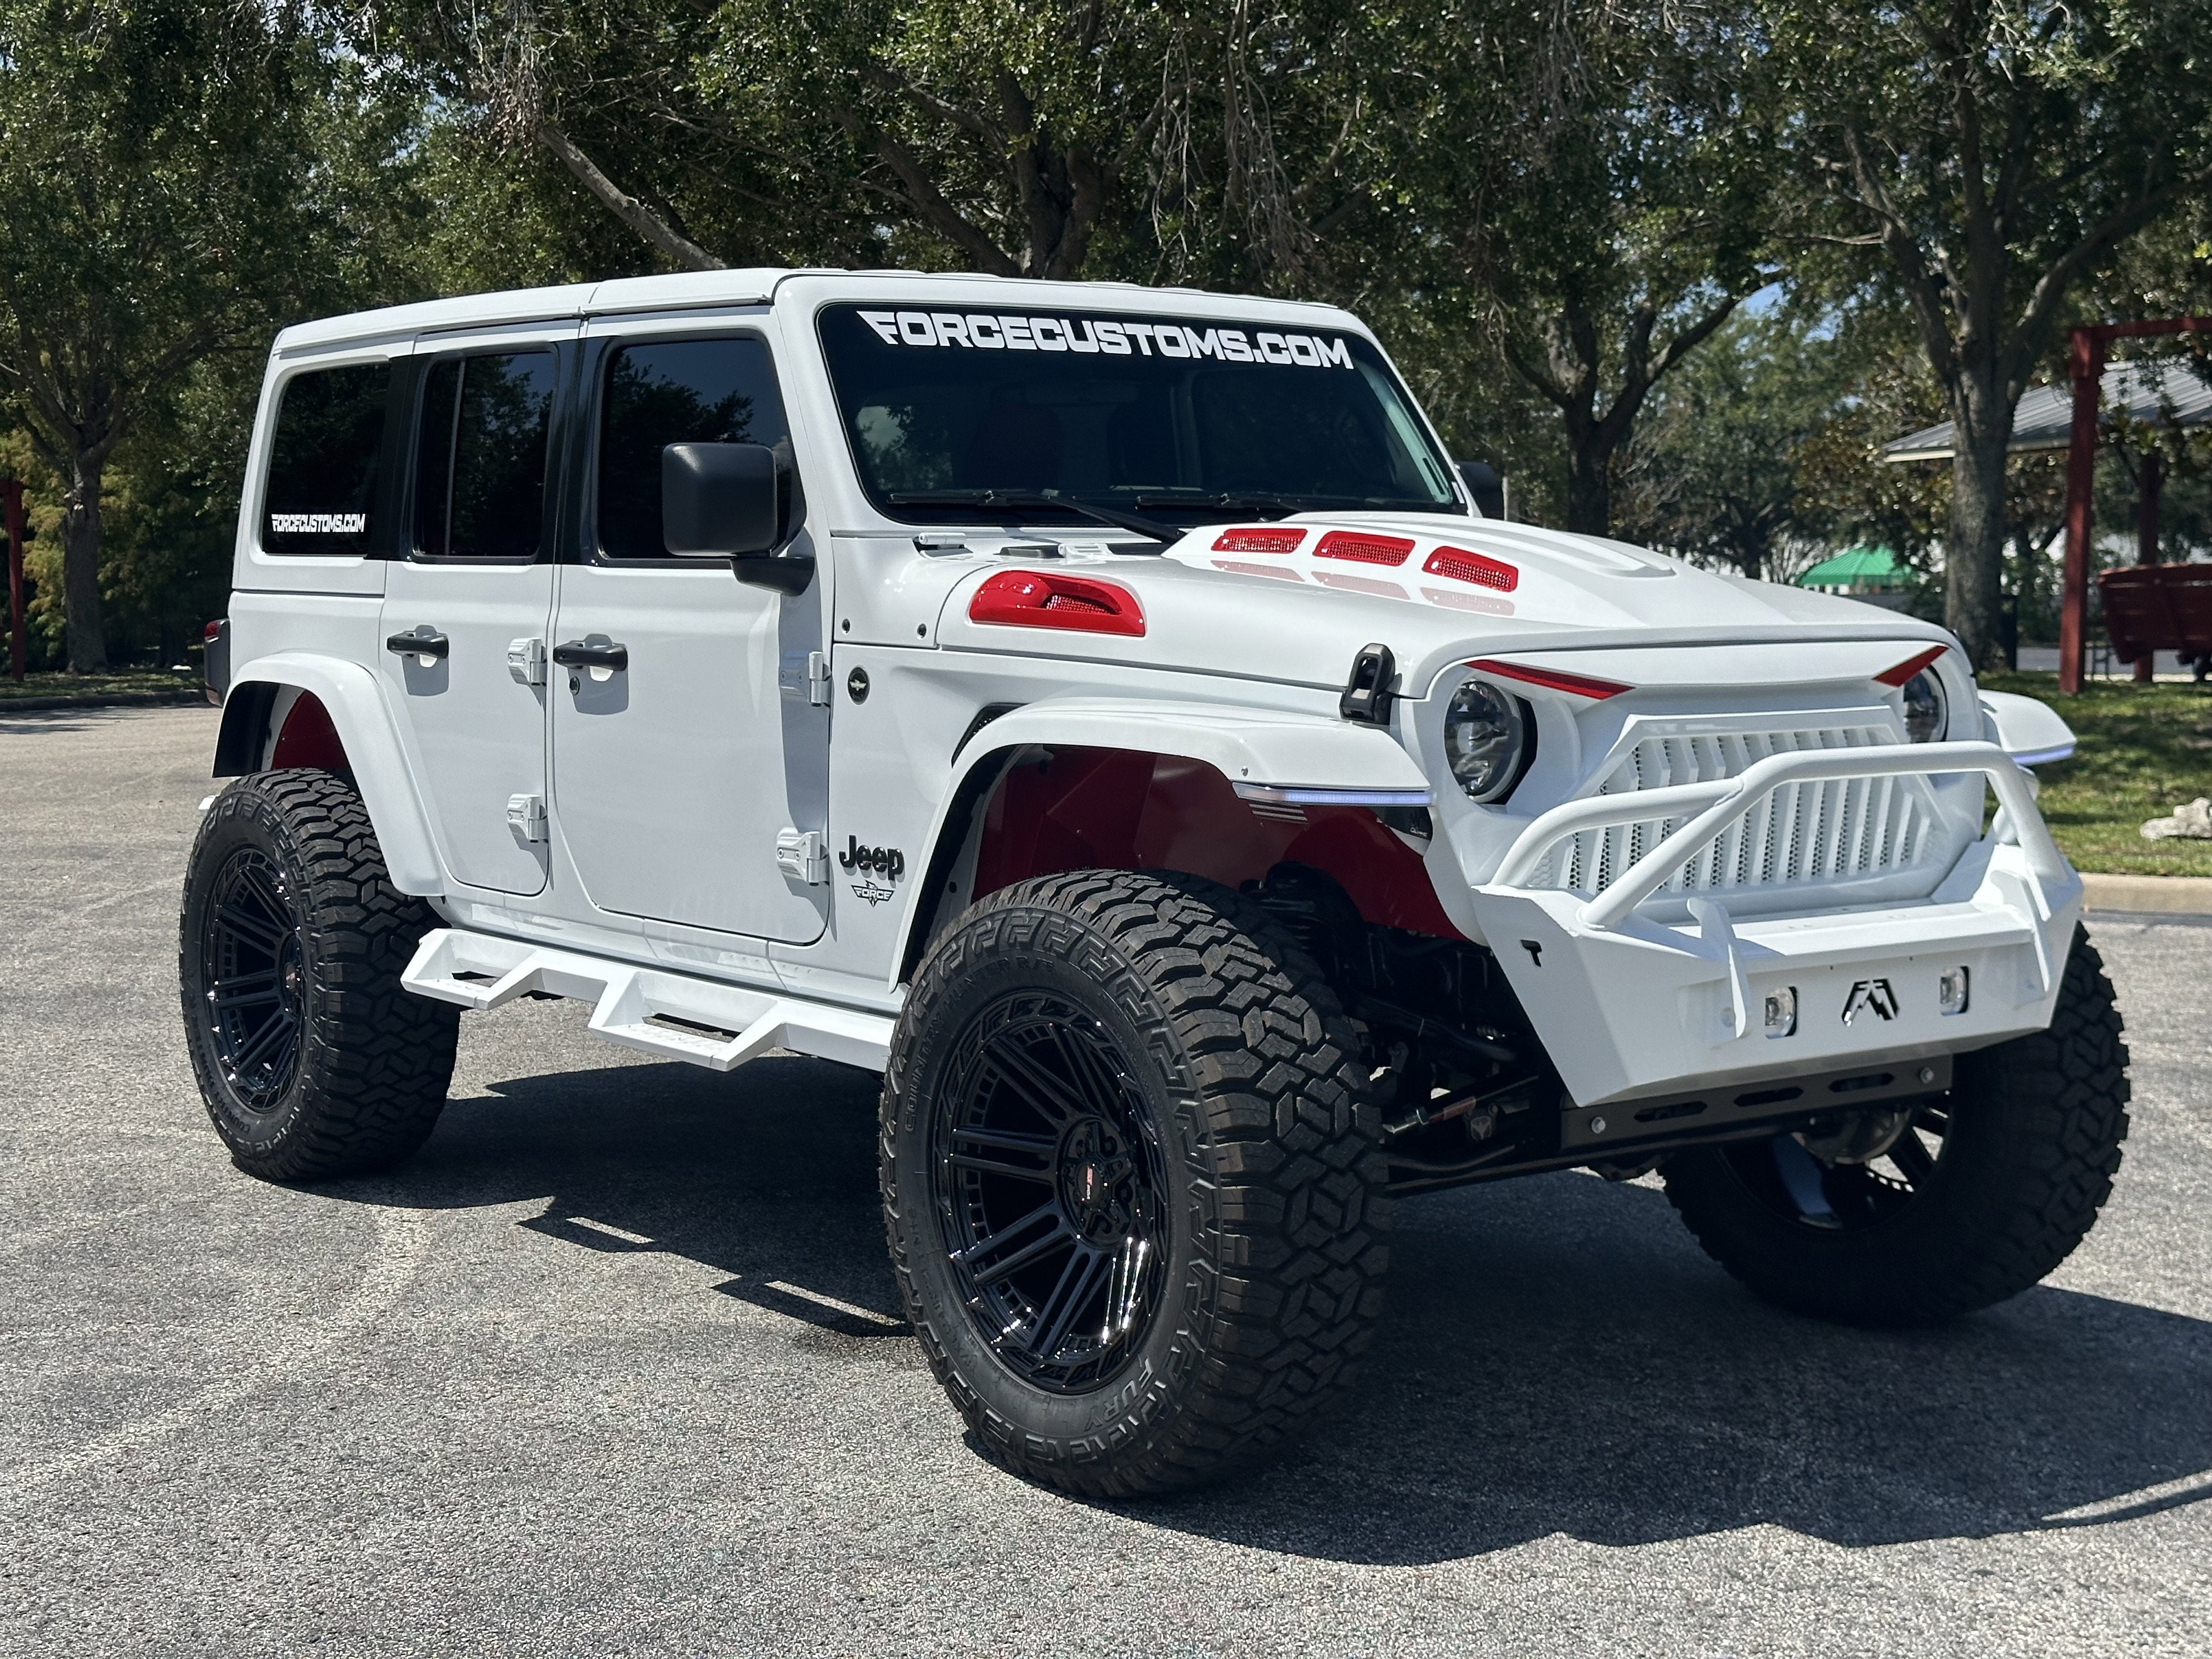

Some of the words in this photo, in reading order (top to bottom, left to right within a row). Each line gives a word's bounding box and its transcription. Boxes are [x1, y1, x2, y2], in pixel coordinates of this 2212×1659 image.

[857, 311, 1353, 369] FORCECUSTOMS.COM
[272, 514, 366, 532] FORCECUSTOMS.COM
[839, 834, 905, 881] Jeep
[904, 1012, 945, 1132] COUNTRY
[943, 957, 1010, 1007] HUNTER
[1084, 1354, 1155, 1432] FURY
